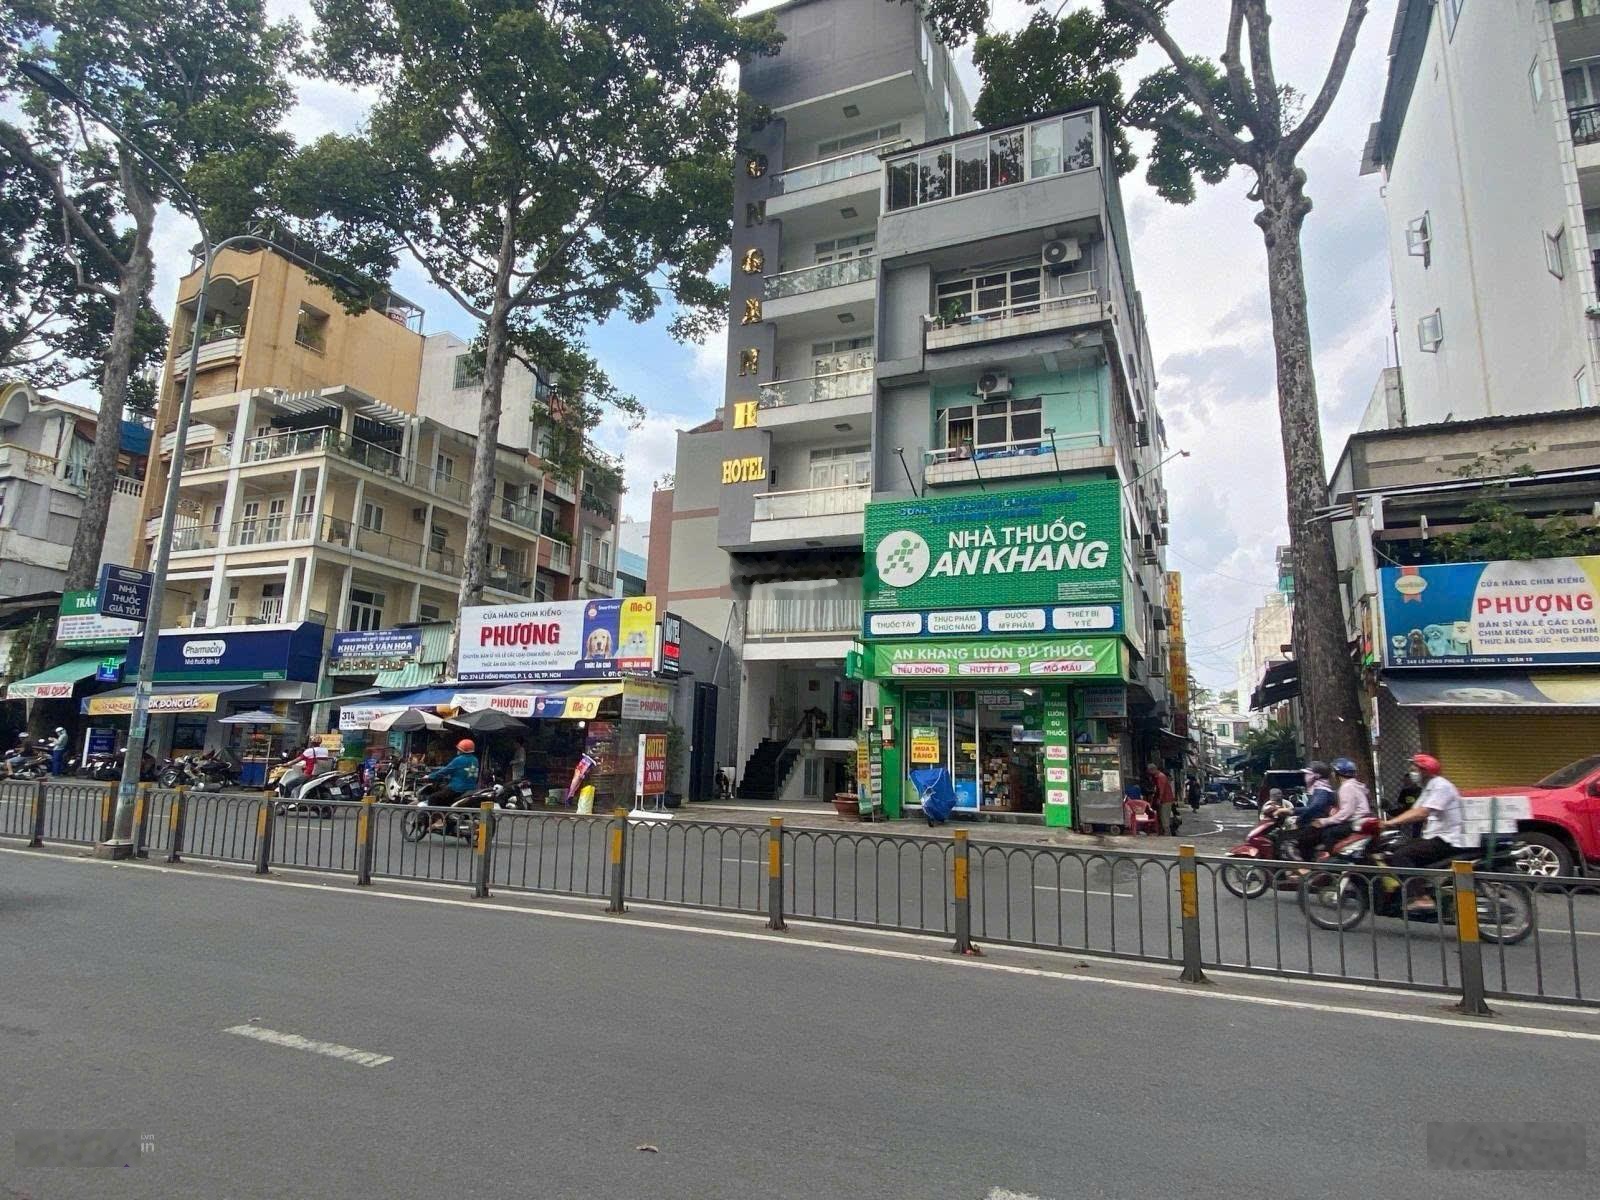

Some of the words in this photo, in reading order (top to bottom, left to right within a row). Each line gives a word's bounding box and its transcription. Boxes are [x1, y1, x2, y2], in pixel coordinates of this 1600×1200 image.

[722, 457, 766, 484] HOTEL
[949, 525, 996, 548] NHÀ
[1001, 516, 1086, 543] THUỐC
[930, 550, 981, 577] AN
[983, 541, 1109, 574] KHANG
[1478, 594, 1593, 616] PHƯỢNG
[480, 622, 560, 650] PHƯỢNG
[893, 648, 912, 660] AN
[917, 648, 968, 659] KHANG
[974, 644, 1013, 658] LUÔN
[1043, 641, 1093, 657] THUỐC
[341, 712, 354, 720] 374
[647, 739, 665, 757] HOTEL
[646, 761, 664, 771] SONG
[647, 772, 662, 782] ANH
